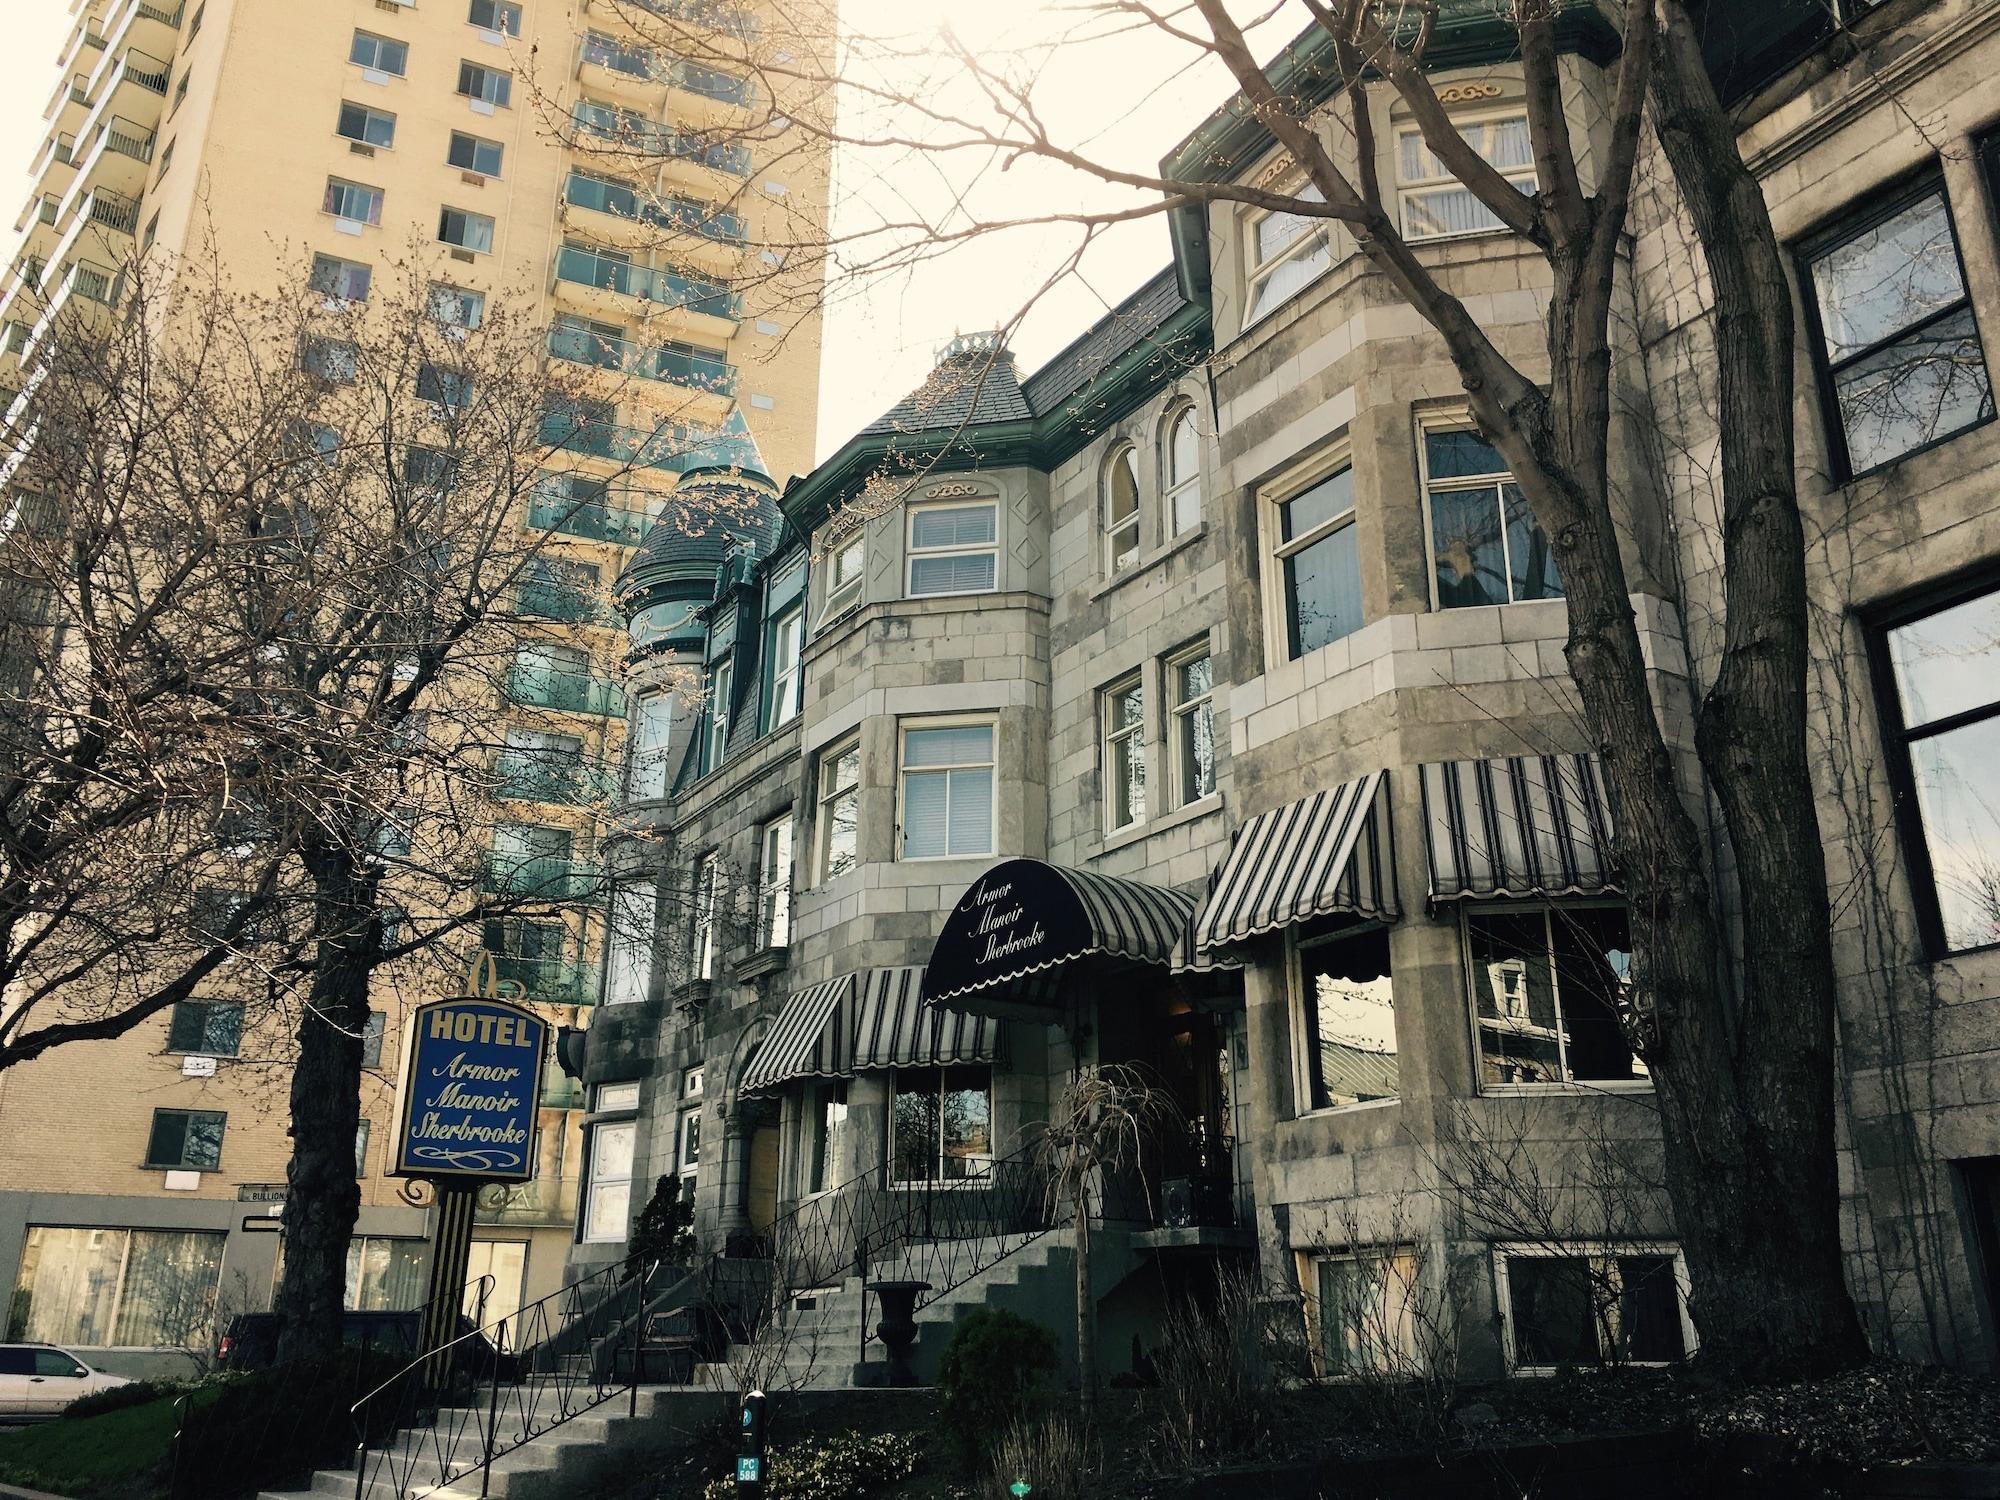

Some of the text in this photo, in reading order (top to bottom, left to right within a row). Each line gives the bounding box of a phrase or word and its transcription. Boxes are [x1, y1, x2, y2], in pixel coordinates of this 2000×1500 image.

[960, 879, 1013, 912] Armor
[968, 902, 1023, 938] Manoir
[975, 921, 1045, 965] Sherbrooke
[430, 1010, 531, 1047] HOTEL
[432, 1051, 521, 1082] Armor
[426, 1082, 520, 1112] Manoir
[411, 1111, 527, 1144] Sherbrooke
[252, 1192, 283, 1200] BULLION
[739, 1471, 755, 1480] 588
[743, 1459, 755, 1469] PC
